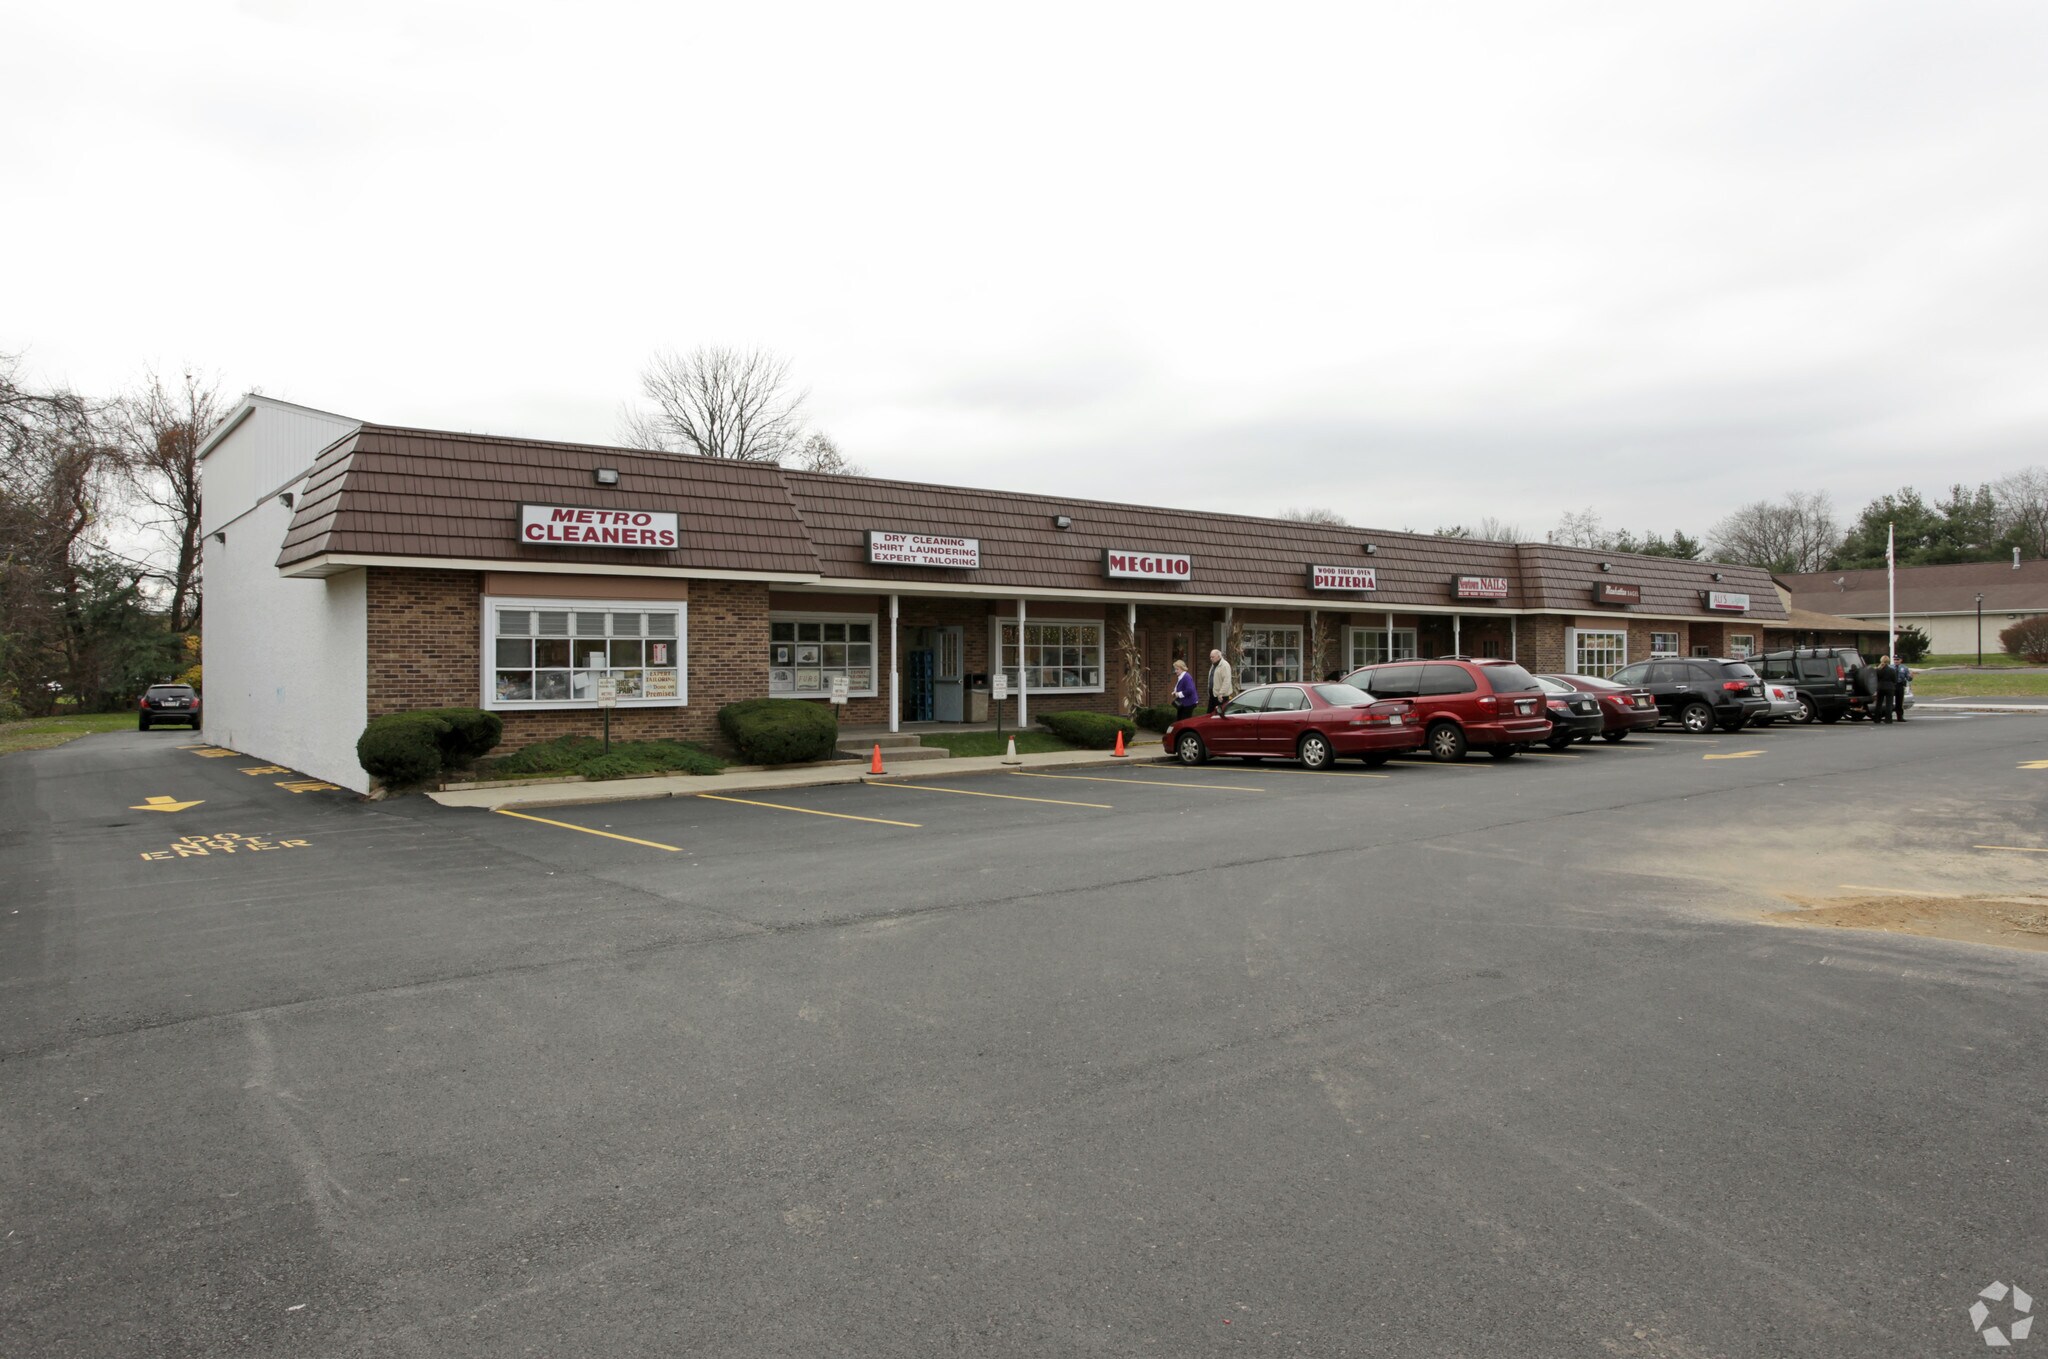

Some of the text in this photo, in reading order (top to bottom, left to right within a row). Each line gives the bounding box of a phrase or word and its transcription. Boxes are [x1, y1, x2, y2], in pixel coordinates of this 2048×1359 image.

[551, 509, 652, 526] METRO
[525, 523, 675, 546] CLEANERS
[884, 534, 965, 547] DRY CLEANING
[872, 543, 977, 557] SHIRT LAUNDERING
[874, 553, 977, 566] EXPERT TAILORING
[1110, 555, 1189, 575] MEGLIO
[1315, 575, 1375, 588] PIZZERIA
[1480, 578, 1506, 590] NAILS
[798, 675, 818, 683] FURS
[616, 686, 633, 694] EPAIR
[645, 690, 675, 698] Premises
[170, 837, 271, 851] NOT
[180, 833, 241, 843] DO
[140, 840, 312, 861] ENTER
